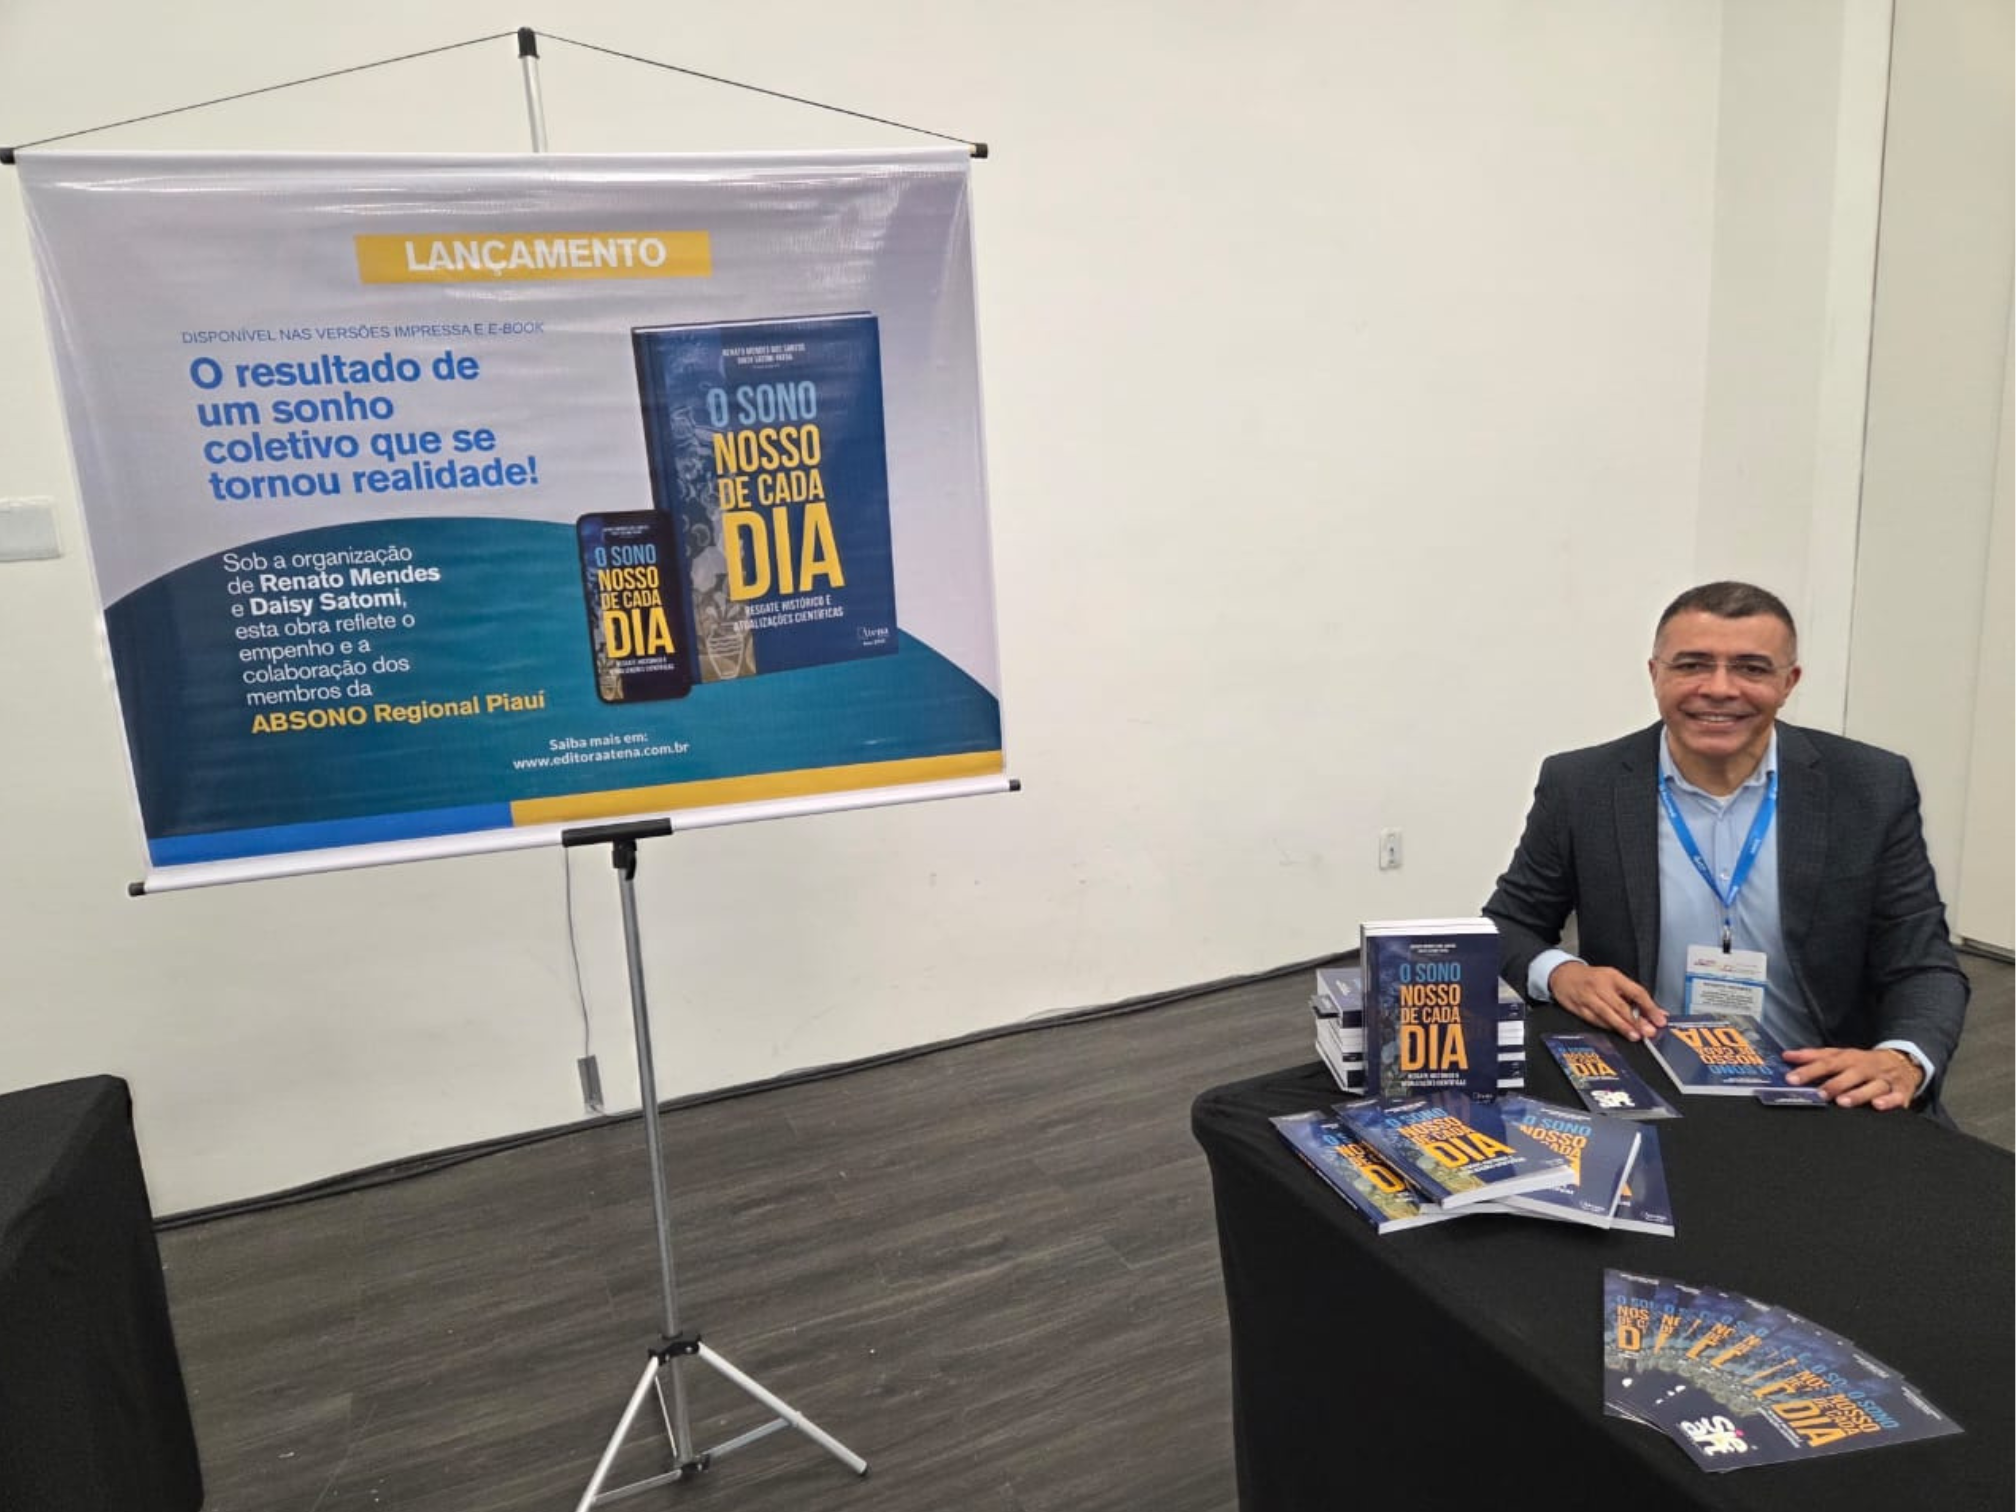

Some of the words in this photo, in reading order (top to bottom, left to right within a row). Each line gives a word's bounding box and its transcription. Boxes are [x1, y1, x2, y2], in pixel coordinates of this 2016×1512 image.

[405, 238, 666, 276] LANÇAMENTO
[182, 327, 276, 345] DISPONÍVEL
[279, 328, 313, 341] NAS
[315, 323, 391, 341] VERSÕES
[394, 323, 471, 339] IMPRESSA
[474, 323, 484, 335] E
[487, 320, 545, 336] E-BOOK
[190, 357, 223, 390] O
[236, 352, 422, 388] resultado
[432, 350, 480, 381] de
[197, 398, 260, 427] um
[272, 390, 394, 421] sonho
[708, 388, 729, 427] O
[739, 381, 817, 425] SONO
[203, 430, 359, 464] coletivo
[370, 433, 443, 463] que
[452, 428, 496, 453] se
[713, 425, 821, 475] NOSSO
[209, 466, 340, 500] tornou
[353, 456, 539, 494] realidade!
[718, 476, 751, 510] DE
[758, 469, 824, 504] CADA
[223, 552, 268, 572] Sob
[273, 557, 286, 570] a
[291, 546, 413, 572] organização
[595, 547, 607, 567] O
[611, 544, 657, 566] SONO
[721, 501, 845, 600] DIA
[227, 574, 255, 595] de
[260, 569, 344, 594] Renato
[350, 565, 441, 587] Mendes
[598, 566, 659, 591] NOSSO
[231, 603, 244, 617] e
[250, 596, 314, 621] Daisy
[320, 590, 408, 612] Satomi,
[601, 591, 619, 610] DE
[623, 589, 661, 608] CADA
[745, 602, 779, 616] RESGATE
[782, 596, 824, 611] HISTÓRICO
[826, 594, 832, 606] E
[235, 620, 279, 640] esta
[284, 616, 331, 636] obra
[336, 612, 397, 631] reflete
[402, 614, 416, 628] o
[603, 607, 675, 658] DIA
[239, 640, 334, 666] empenho
[340, 641, 353, 655] e
[358, 639, 371, 653] a
[242, 660, 367, 686] colaboração
[372, 656, 410, 674] dos
[246, 684, 343, 707] membros
[346, 680, 373, 699] da
[251, 706, 368, 734] ABSONO
[374, 695, 481, 726] Regional
[486, 689, 546, 713] Piauí
[512, 740, 690, 771] www.editoraatena.com.br
[549, 736, 587, 751] Saiba
[590, 734, 622, 748] mais
[623, 733, 648, 746] em:
[1400, 963, 1411, 982] O
[1416, 962, 1461, 982] SONO
[1400, 984, 1461, 1006] NOSSO
[1401, 1007, 1419, 1023] DE
[1422, 1006, 1460, 1023] CADA
[1400, 1024, 1468, 1071] DIA
[1670, 1027, 1751, 1047] DIA
[1570, 1063, 1618, 1076] DIA
[1398, 1116, 1463, 1138] NOSSO
[1403, 1107, 1448, 1122] SONO
[1523, 1115, 1535, 1125] O
[1542, 1117, 1592, 1136] SONO
[1422, 1132, 1516, 1168] DIA
[1520, 1125, 1587, 1149] NOSSO
[1617, 1305, 1650, 1320] NOS
[1849, 1391, 1866, 1399] O
[1771, 1400, 1847, 1447] DIA
[1827, 1393, 1881, 1432] NOSSO
[1857, 1399, 1900, 1428] SONO
